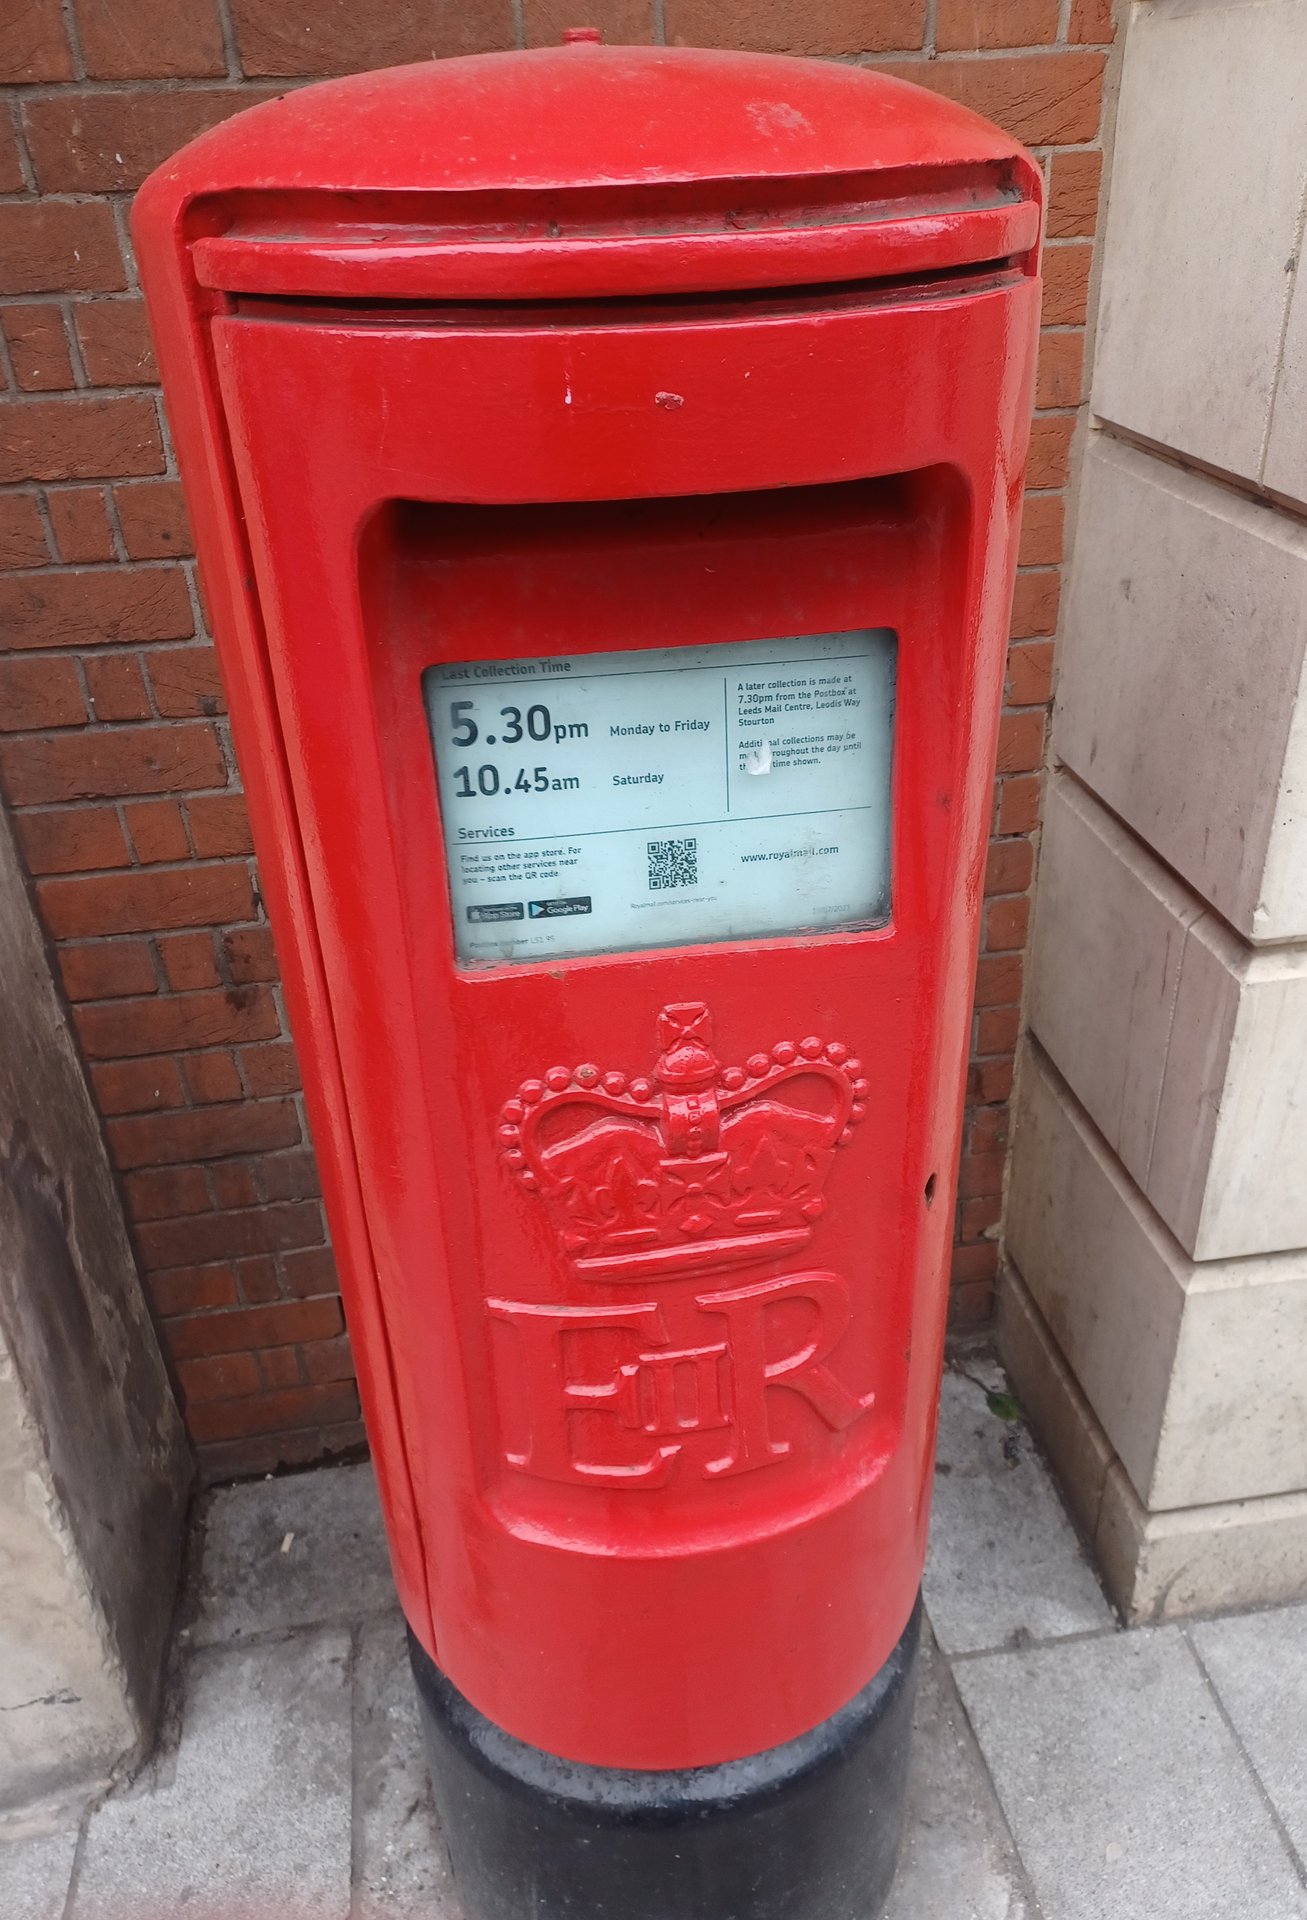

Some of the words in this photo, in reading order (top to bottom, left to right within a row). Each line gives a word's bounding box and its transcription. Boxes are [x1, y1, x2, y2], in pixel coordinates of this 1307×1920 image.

[442, 669, 471, 680] Last
[474, 664, 535, 678] Collection
[539, 659, 572, 673] Time
[738, 683, 744, 691] A
[746, 682, 765, 690] later
[768, 679, 806, 689] collection
[819, 676, 841, 684] made
[738, 694, 773, 704] 7.30pm
[776, 692, 796, 700] from
[798, 690, 812, 699] the
[814, 689, 846, 698] Postbox
[738, 706, 762, 715] Leeds
[765, 705, 782, 713] Mail
[784, 703, 814, 712] Centre,
[816, 700, 842, 709] Leodis
[844, 698, 860, 707] Way
[450, 701, 588, 747] 5.30pm
[610, 724, 655, 736] Monday
[659, 722, 670, 732] to
[674, 720, 710, 731] Friday
[739, 717, 774, 726] Stourton
[739, 739, 780, 748] Additinal
[782, 735, 824, 745] collections
[772, 747, 809, 758] roughout
[812, 745, 824, 753] the
[827, 744, 841, 752] day
[844, 742, 862, 751] until
[772, 760, 790, 768] time
[453, 764, 580, 797] 10.45am
[612, 773, 664, 786] Saturday
[458, 826, 515, 839] Services
[524, 851, 539, 859] app
[741, 846, 838, 862] www.royalmail.com
[461, 864, 496, 874] locating
[498, 862, 520, 870] other
[523, 860, 557, 869] services
[462, 877, 478, 885] you
[488, 874, 506, 882] scan
[525, 872, 538, 880] QR
[546, 904, 572, 914] Google
